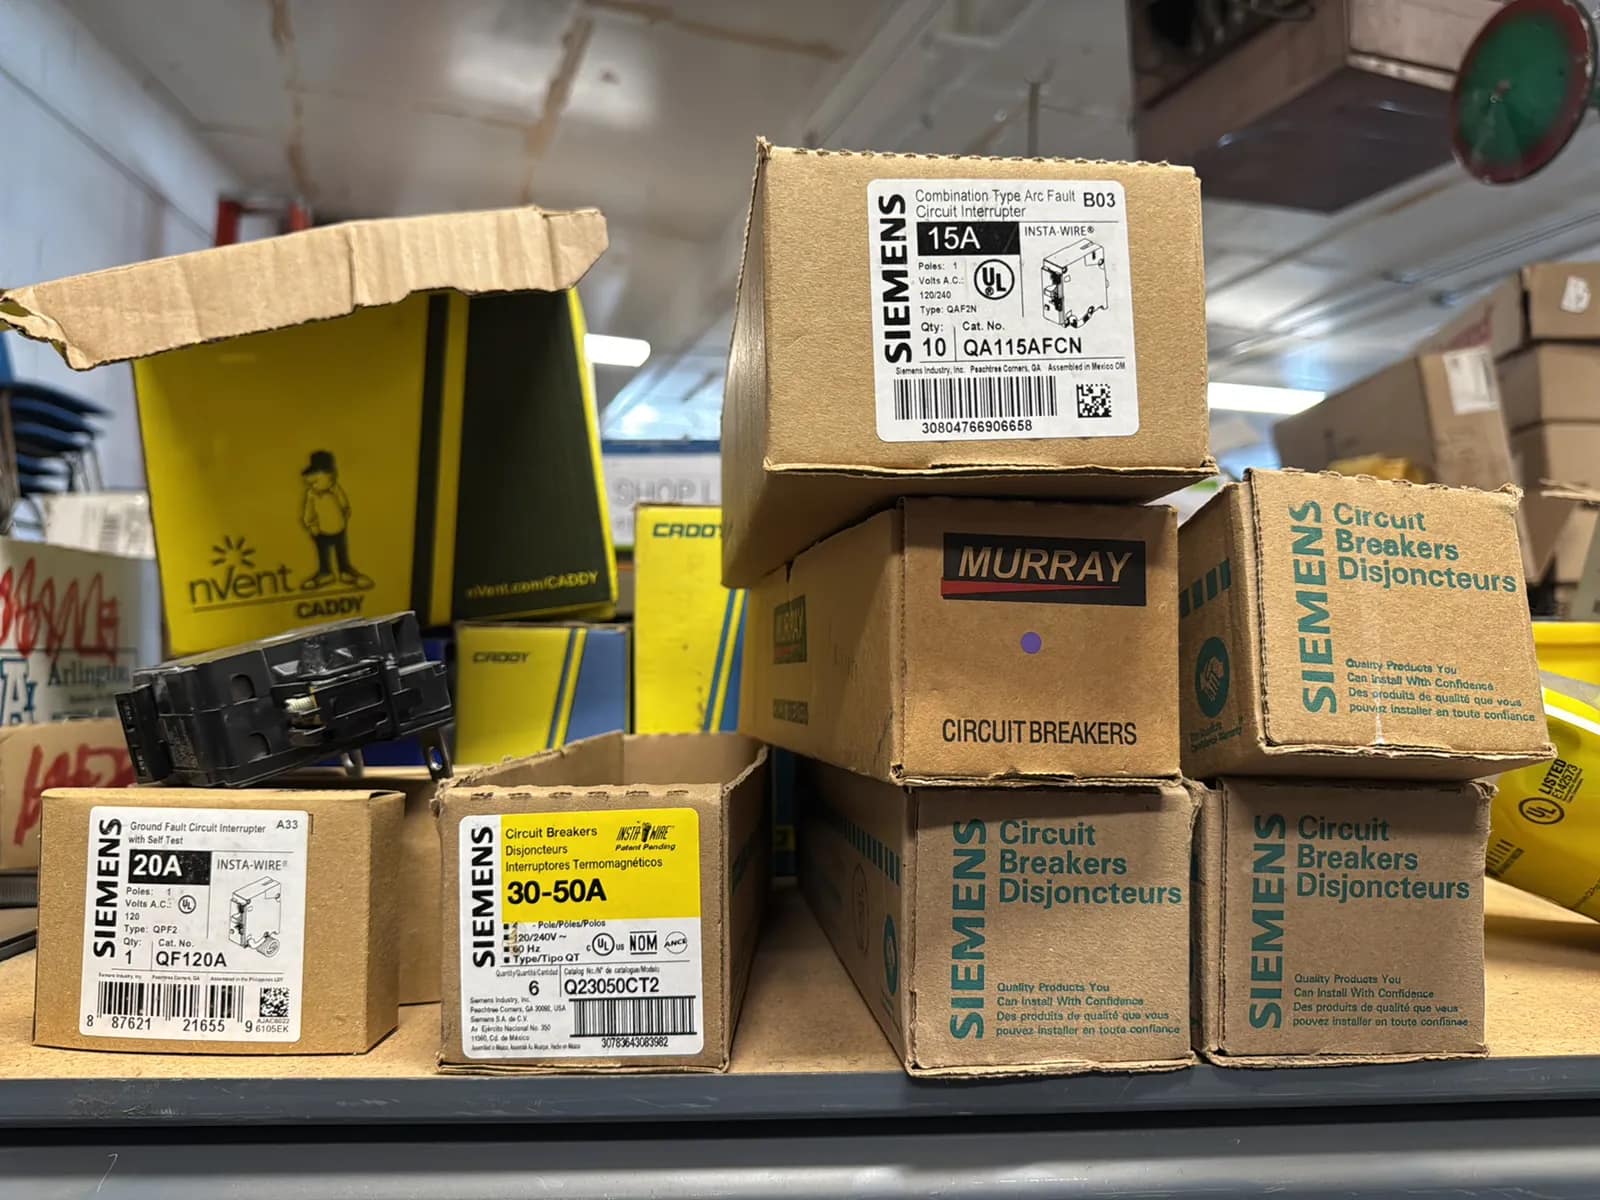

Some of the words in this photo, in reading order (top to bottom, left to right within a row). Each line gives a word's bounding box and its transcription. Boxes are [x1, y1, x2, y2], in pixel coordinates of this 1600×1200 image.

[916, 190, 989, 202] Combination
[992, 190, 1020, 204] Type
[1024, 190, 1043, 201] Arc
[1048, 190, 1075, 201] Fault
[1084, 192, 1116, 207] B03
[916, 205, 956, 218] Circuit
[962, 206, 1026, 220] Interrupter
[928, 226, 980, 249] 15A
[918, 262, 944, 270] Poles:
[879, 194, 912, 363] SIEMENS
[919, 276, 940, 285] Volts
[920, 305, 943, 315] Type:
[921, 322, 943, 334] Qty:
[963, 321, 982, 331] Cat.
[987, 321, 1005, 331] No.
[922, 339, 947, 357] 10
[964, 337, 1082, 356] QA115AFCN
[896, 367, 922, 375] Siemens
[970, 365, 1001, 373] Peachtree
[1048, 363, 1082, 372] Assembled
[922, 420, 1032, 434] 30804766906658
[1333, 503, 1426, 531] Circuit
[1336, 529, 1459, 561] Breakers
[958, 546, 1133, 583] MURRAY
[1338, 556, 1516, 593] Disjoncteurs
[189, 564, 293, 604] nVent
[296, 596, 364, 619] CADDY
[1288, 500, 1337, 714] SIEMENS
[1387, 661, 1432, 673] Products
[1438, 665, 1456, 675] You
[1347, 673, 1367, 683] Can
[1406, 677, 1431, 686] With
[1349, 688, 1368, 697] Des
[1419, 693, 1431, 701] de
[1474, 696, 1493, 705] que
[1497, 699, 1522, 707] vous
[1391, 705, 1432, 715] installer
[1453, 709, 1480, 719] toute
[1484, 711, 1535, 722] confiance
[942, 719, 1027, 743] CIRCUIT
[1030, 721, 1137, 745] BREAKERS
[1538, 759, 1566, 794] LISTED
[130, 821, 162, 832] Ground
[165, 822, 186, 832] Fault
[189, 823, 217, 832] Circuit
[220, 824, 265, 835] Interrupter
[277, 820, 298, 829] A33
[1298, 816, 1389, 841] Circuit
[128, 836, 145, 844] with
[147, 836, 163, 844] Self
[505, 829, 542, 839] Circuit
[547, 827, 597, 838] Breakers
[999, 820, 1095, 846] Circuit
[505, 845, 567, 857] Disjoncteurs
[1297, 846, 1417, 870] Breakers
[133, 855, 183, 876] 20A
[505, 859, 570, 872] Interruptores
[573, 858, 662, 873] Termomagnéticos
[999, 849, 1127, 875] Breakers
[94, 819, 121, 958] SIEMENS
[507, 879, 607, 904] 30-50A
[999, 878, 1182, 909] Disjoncteurs
[1297, 873, 1470, 903] Disjoncteurs
[472, 826, 495, 968] SIEMENS
[950, 818, 986, 1040] SIEMENS
[1249, 814, 1286, 1029] SIEMENS
[125, 925, 148, 934] Type:
[153, 926, 177, 934] QPF2
[123, 938, 142, 947] Qty:
[159, 939, 176, 947] Cat.
[526, 945, 540, 953] Hz
[630, 935, 657, 951] NOM
[664, 938, 687, 948] ANCE
[125, 950, 132, 964] 1
[156, 952, 226, 967] QF120A
[513, 955, 563, 964] Type/Tipo
[566, 953, 580, 962] QT
[564, 977, 659, 995] Q23050CT2
[1295, 974, 1329, 984] Quality
[1334, 974, 1377, 984] Products
[1382, 975, 1401, 984] You
[528, 981, 539, 995] 6
[997, 983, 1034, 993] Quality
[1039, 983, 1084, 992] Products
[1090, 983, 1109, 992] You
[1294, 988, 1313, 997] Can
[1318, 988, 1347, 997] Install
[1351, 988, 1374, 997] With
[997, 997, 1017, 1006] Can
[1022, 996, 1052, 1006] Install
[1057, 996, 1080, 1006] With
[1085, 996, 1143, 1006] Confidence
[87, 1015, 93, 1026] 8
[112, 1017, 150, 1030] 87621
[183, 1019, 225, 1032] 21655
[245, 1021, 252, 1032] 9
[997, 1012, 1016, 1021] Des
[1021, 1011, 1063, 1023] produits
[1068, 1012, 1080, 1021] de
[1084, 1010, 1118, 1022] qualité
[1122, 1012, 1141, 1022] que
[1144, 1012, 1168, 1020] vous
[996, 1027, 1033, 1037] pouvez
[1038, 1025, 1079, 1035] installer
[1083, 1027, 1095, 1035] en
[1100, 1025, 1126, 1034] toute
[1129, 1025, 1180, 1034] confiance
